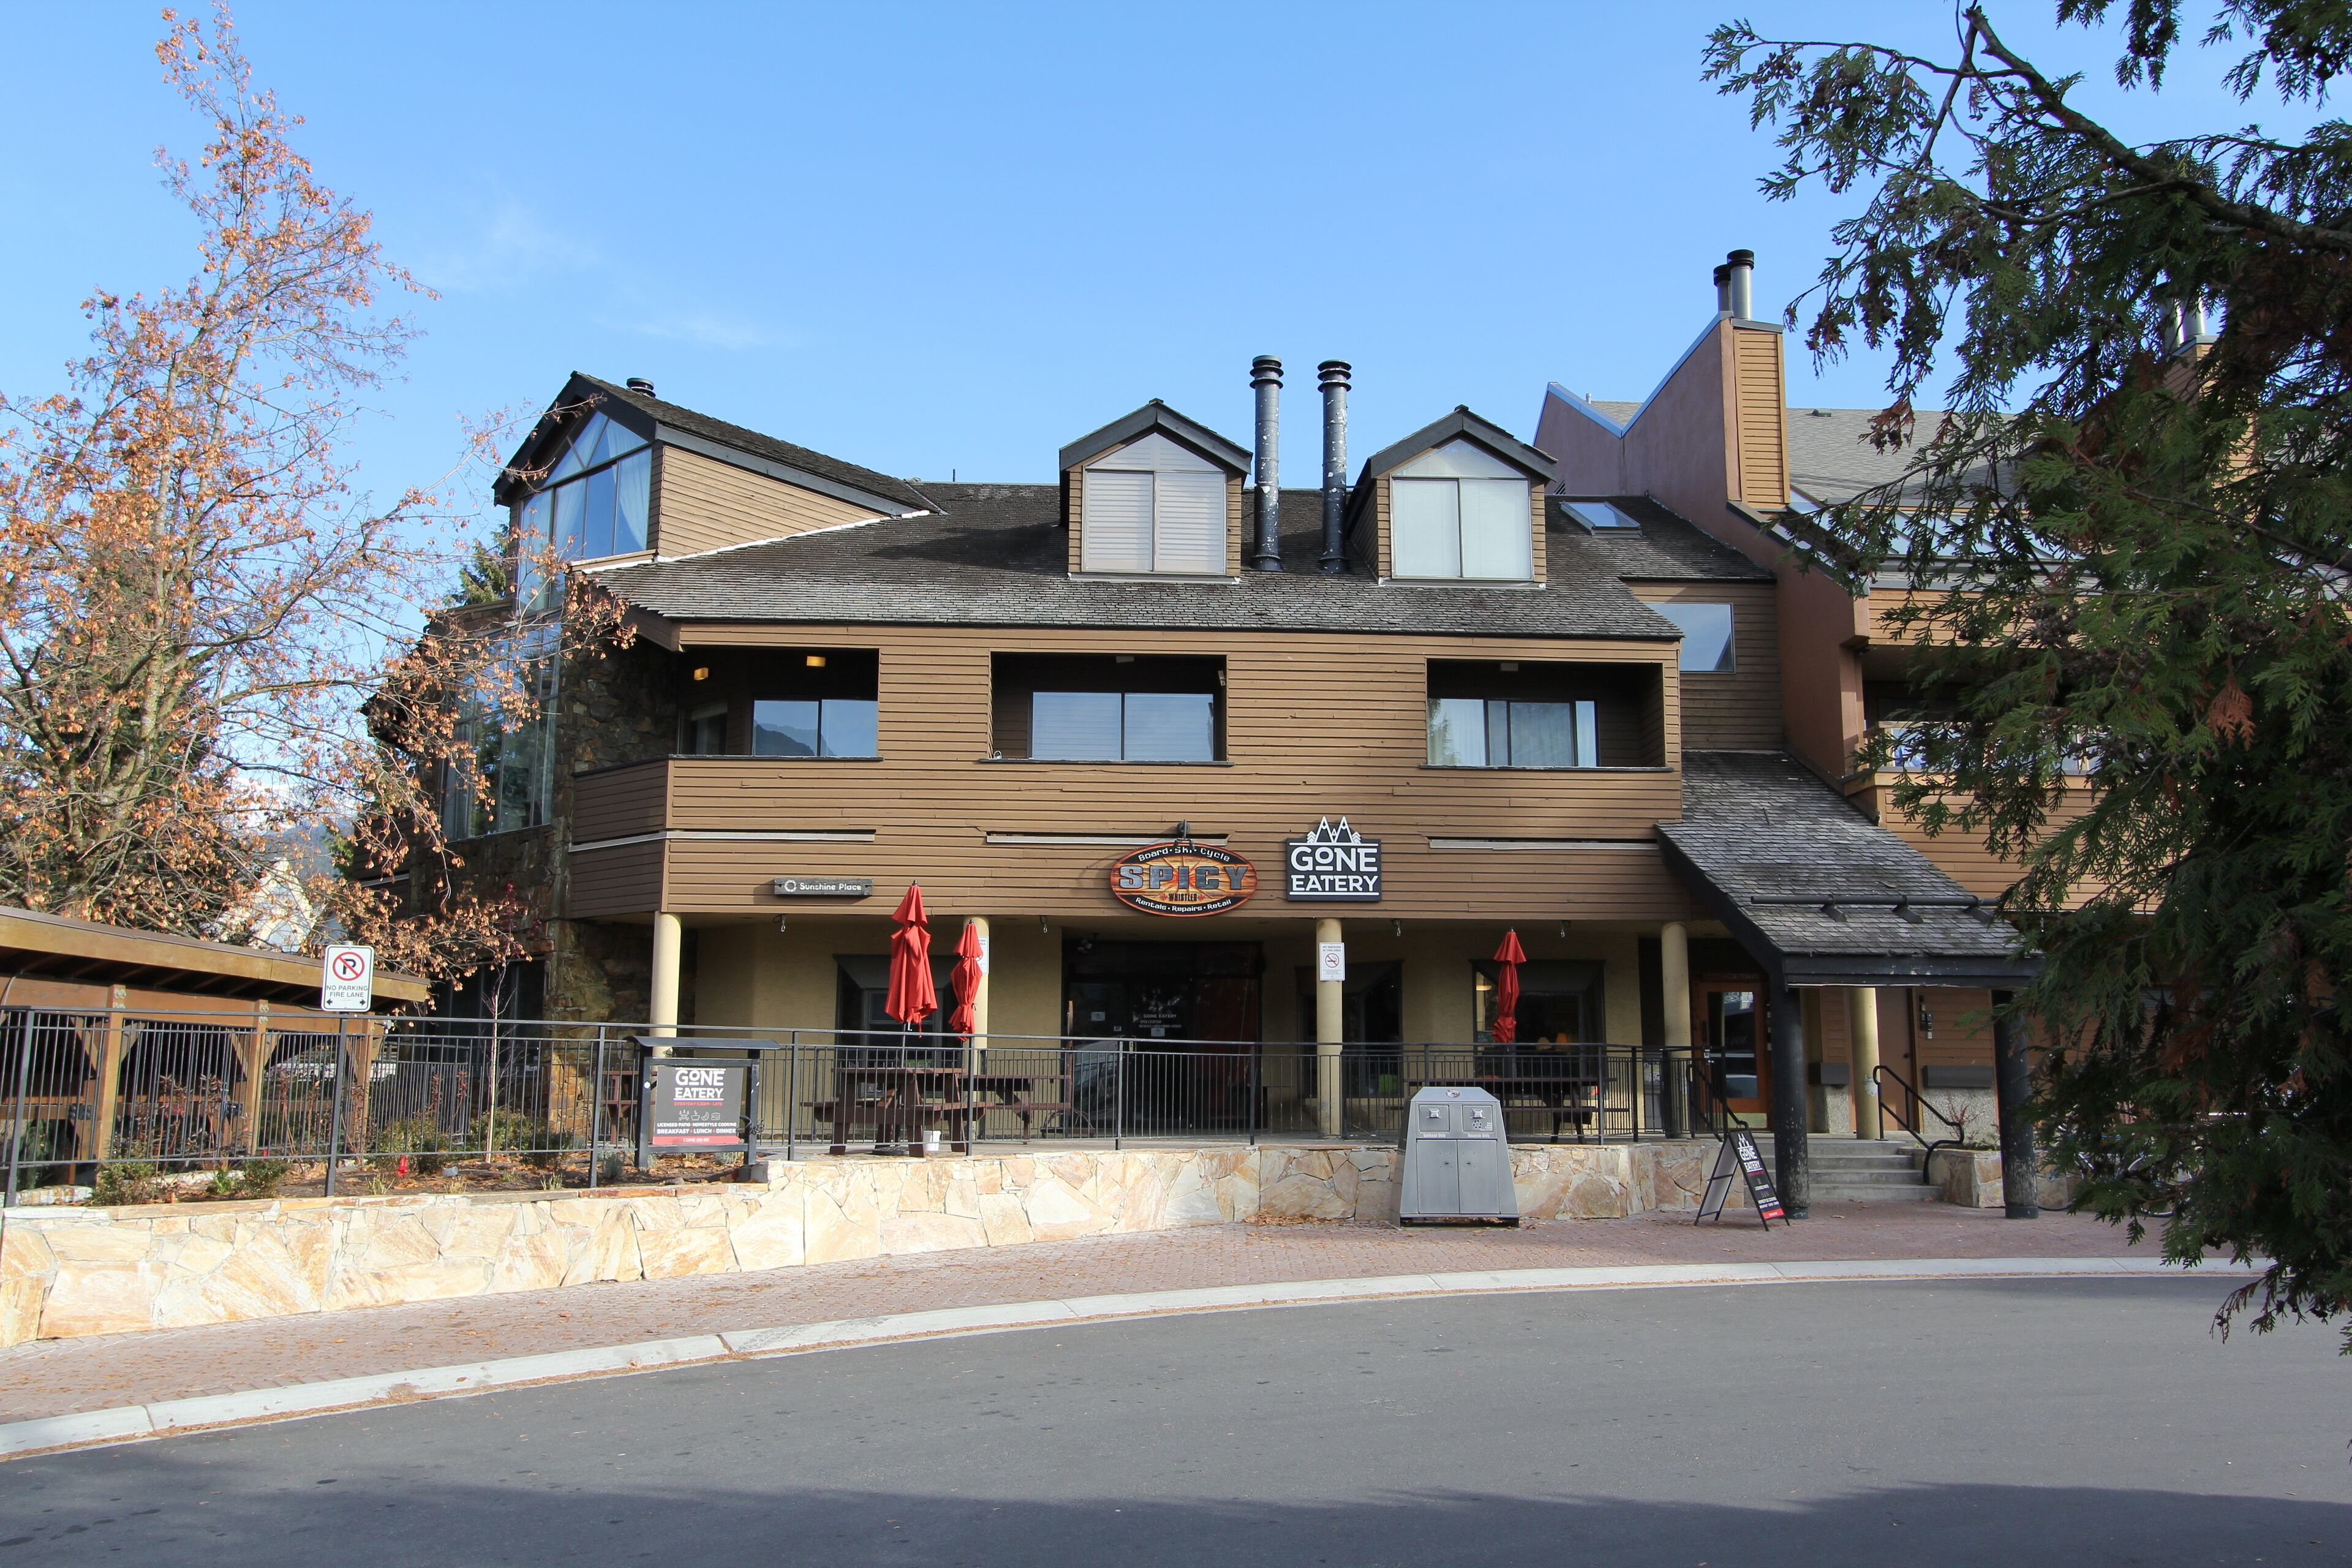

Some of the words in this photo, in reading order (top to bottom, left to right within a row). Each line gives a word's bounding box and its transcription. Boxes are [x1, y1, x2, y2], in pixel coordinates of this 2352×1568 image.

[1138, 847, 1169, 862] Board
[1200, 848, 1230, 862] Cycle
[1291, 846, 1378, 872] GONE
[1119, 865, 1250, 890] SPICY
[1291, 875, 1378, 892] EATERY
[799, 882, 836, 891] Sunshine
[1136, 897, 1167, 910] Rentals
[1207, 899, 1232, 910] Retail
[1169, 893, 1197, 902] WHISTLER
[675, 1070, 725, 1086] GONE
[674, 1087, 724, 1098] EATERY
[1739, 1148, 1757, 1161] GONE
[1744, 1161, 1761, 1170] EATERY
